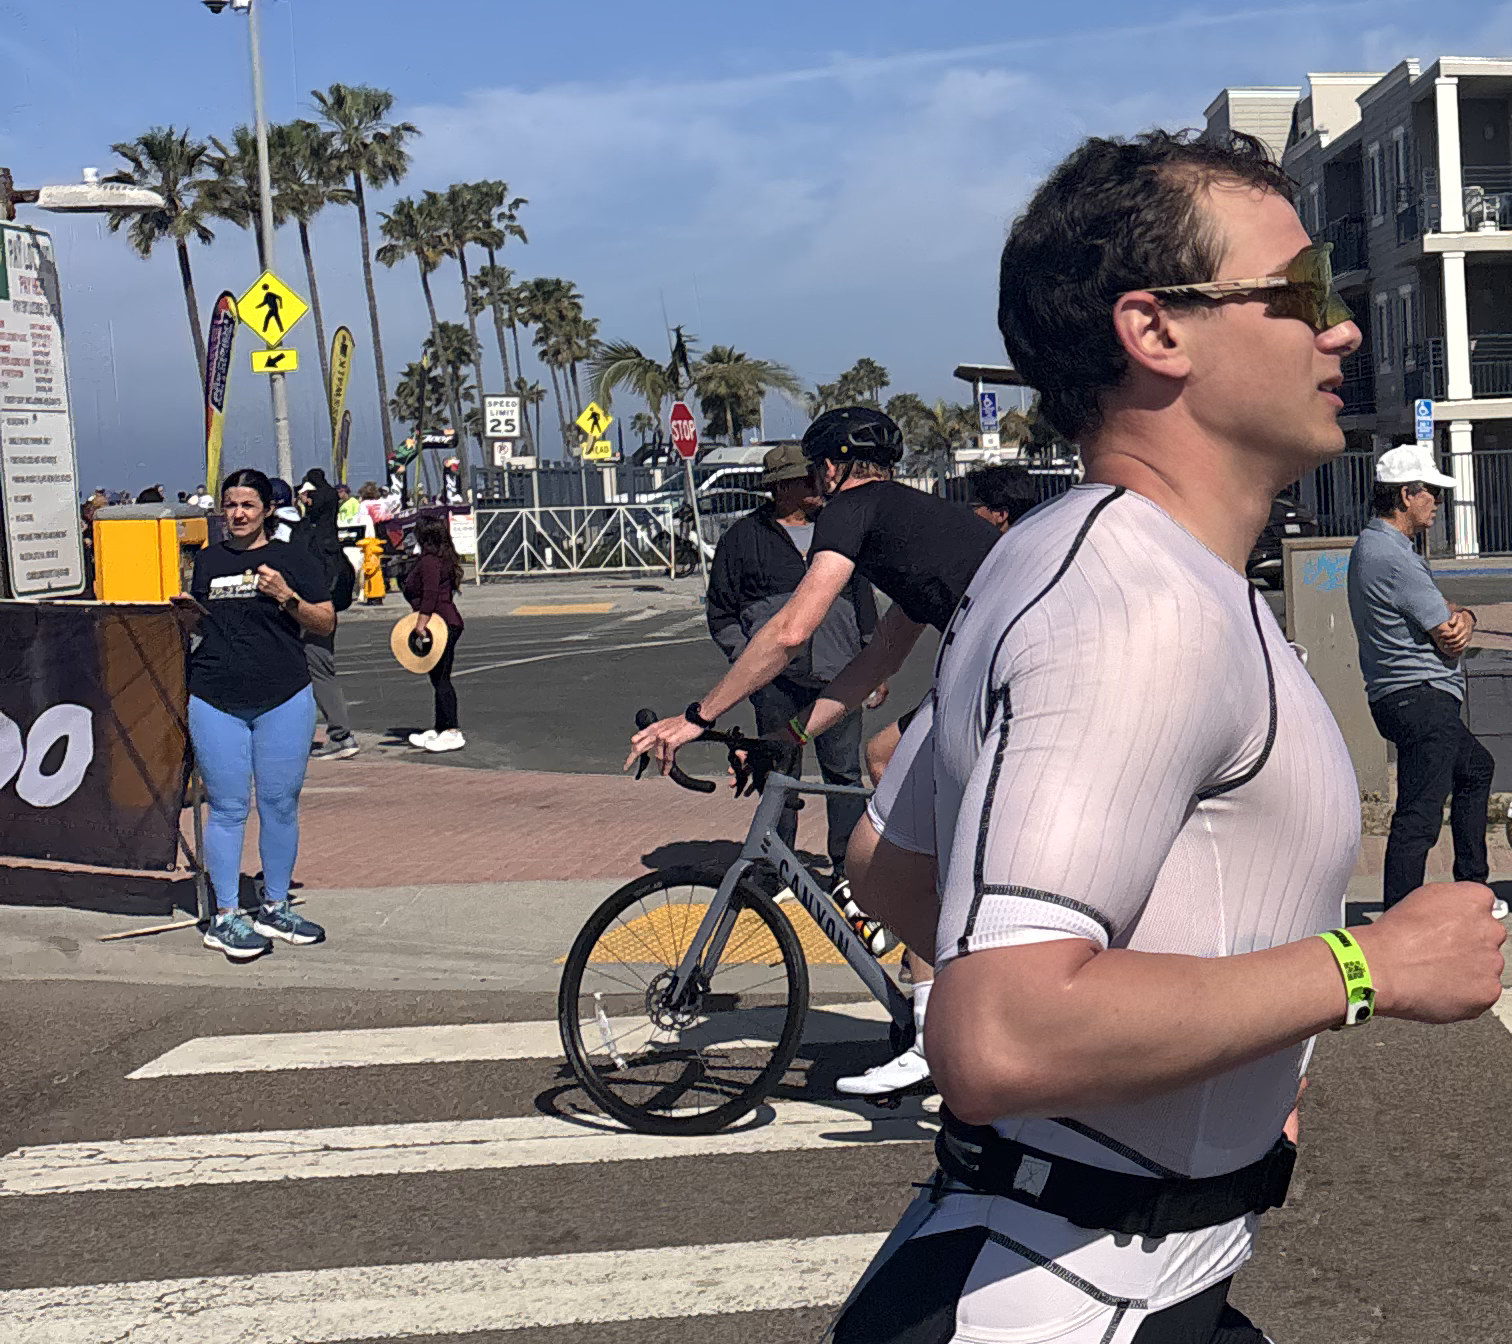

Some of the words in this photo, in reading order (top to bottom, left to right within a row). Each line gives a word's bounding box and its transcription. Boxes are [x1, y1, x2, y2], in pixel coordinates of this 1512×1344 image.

[489, 418, 517, 433] 25
[671, 419, 696, 442] STOP
[779, 859, 849, 957] CANYON
